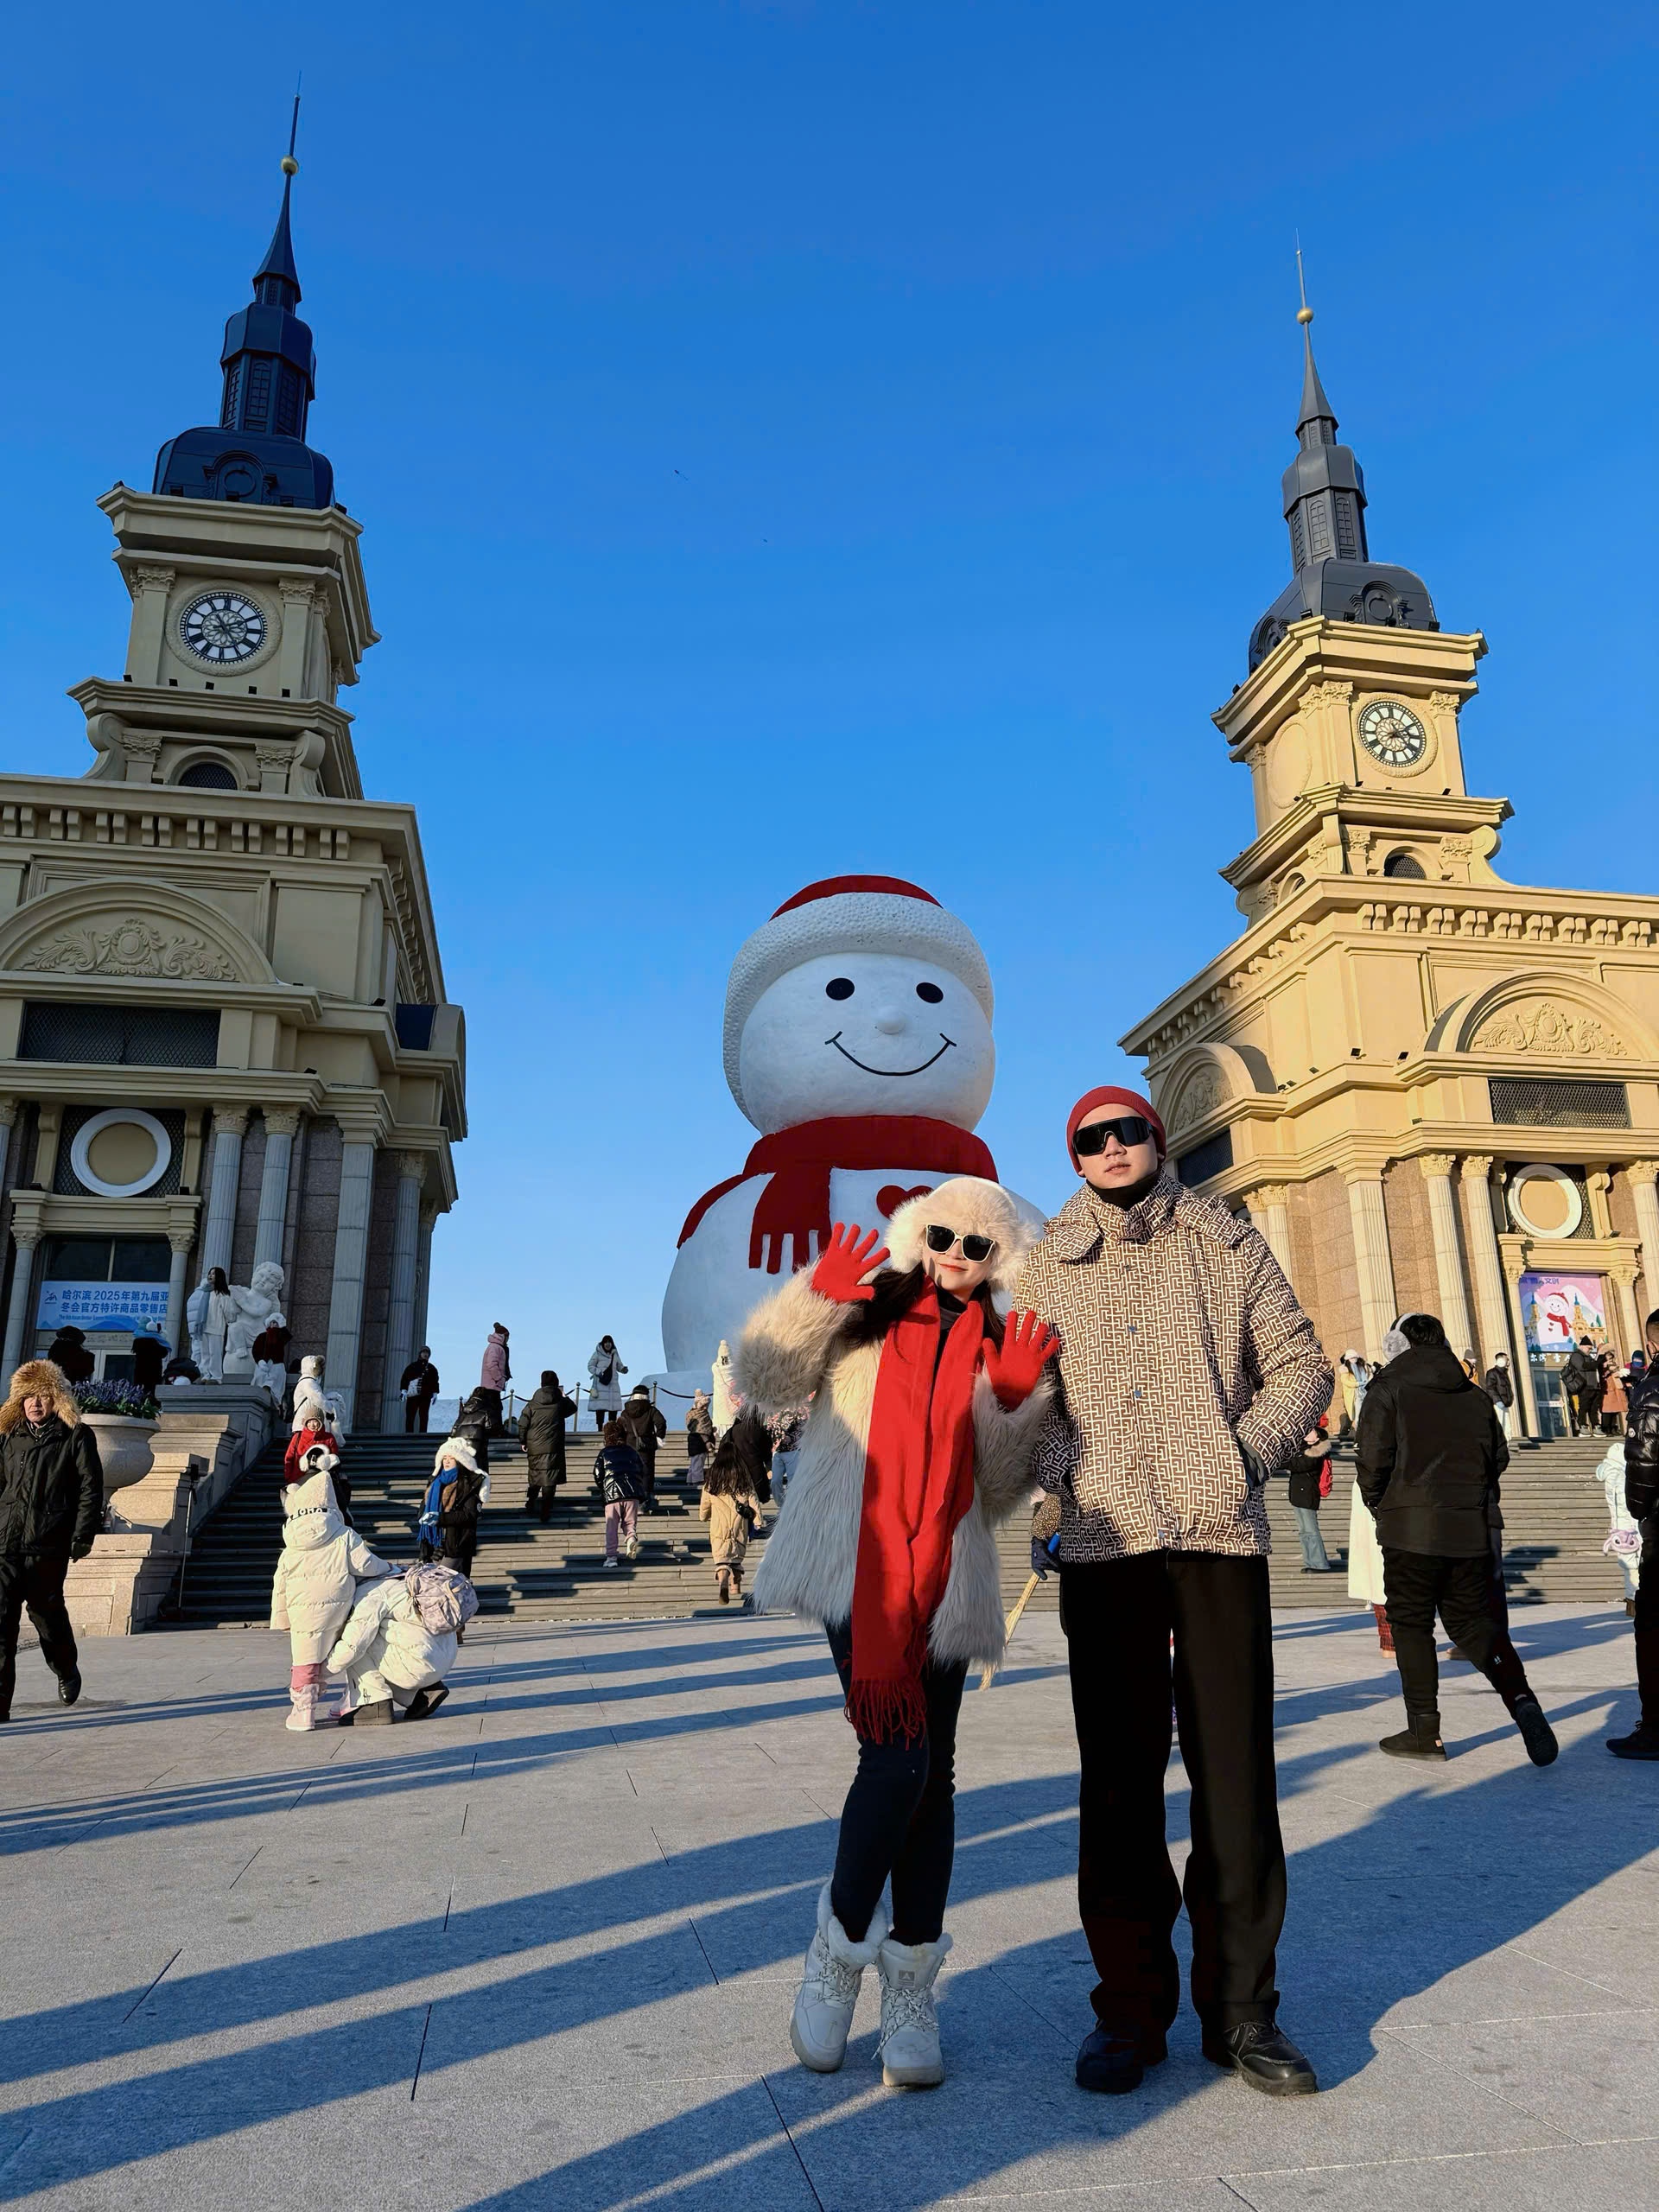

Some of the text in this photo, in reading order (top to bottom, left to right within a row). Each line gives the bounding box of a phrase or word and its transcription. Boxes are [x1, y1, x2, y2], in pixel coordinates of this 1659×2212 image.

[60, 1302, 168, 1313] 冬会官方特许商品零售店
